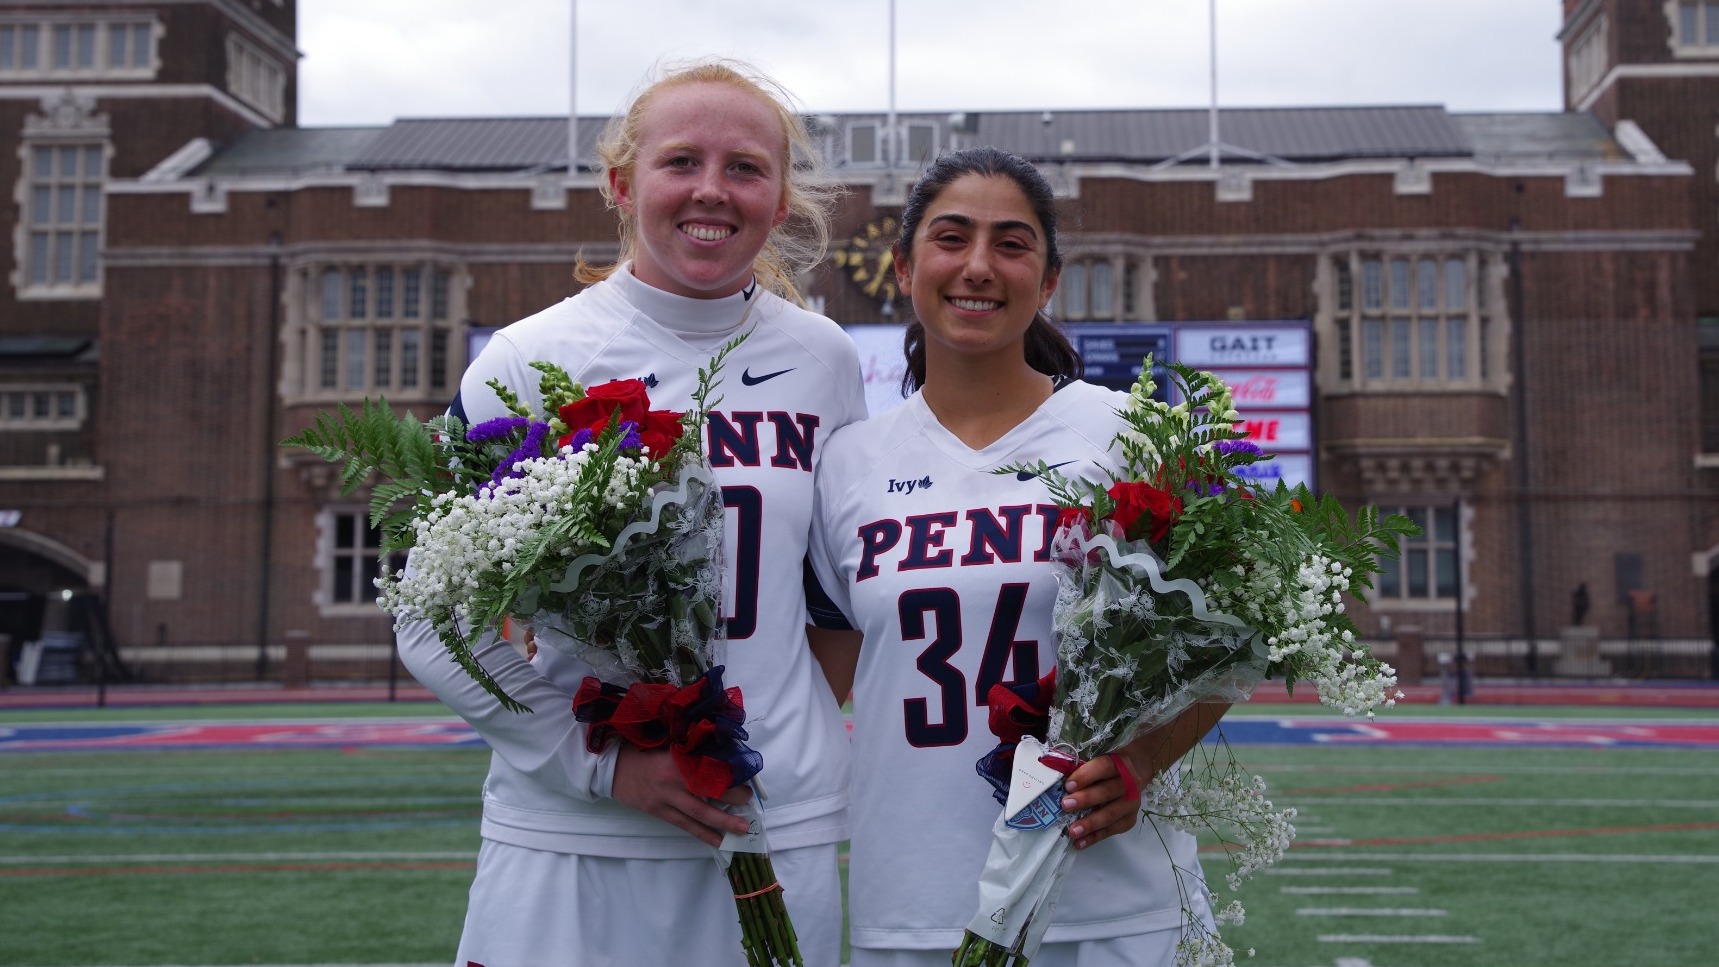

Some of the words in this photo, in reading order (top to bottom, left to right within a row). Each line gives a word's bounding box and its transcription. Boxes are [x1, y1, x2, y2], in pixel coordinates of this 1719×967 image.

[1210, 335, 1276, 352] GAIT
[707, 410, 820, 473] NN
[1231, 420, 1279, 441] ME
[887, 479, 917, 495] Ivy
[714, 484, 762, 640] 0
[856, 503, 1057, 583] PEN
[898, 582, 1041, 748] 34
